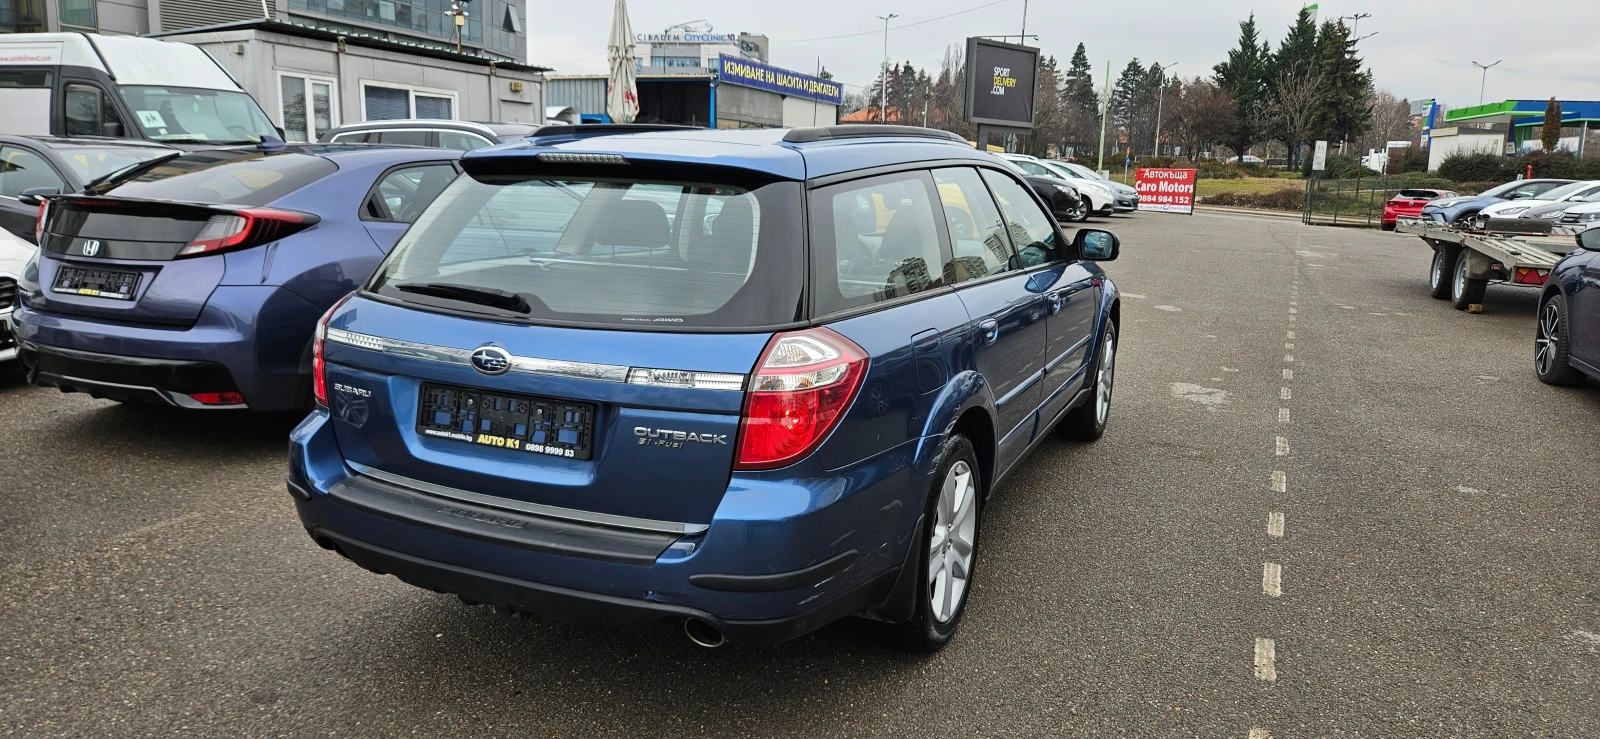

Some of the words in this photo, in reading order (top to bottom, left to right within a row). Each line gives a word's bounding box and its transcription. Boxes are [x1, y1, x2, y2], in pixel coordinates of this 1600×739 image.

[994, 66, 1010, 77] SPORT
[724, 60, 764, 82] ИЗМИВАНЕ
[765, 70, 775, 83] НА
[776, 73, 803, 90] ШАСИТА
[803, 80, 809, 91] И
[808, 81, 839, 98] ДВИГАТЕЛИ
[994, 76, 1016, 87] DELIVERY
[991, 85, 1005, 95] .COM
[1135, 180, 1157, 191] Caro
[1158, 180, 1194, 193] Motors
[1157, 195, 1173, 203] 984
[1174, 196, 1190, 204] 152
[334, 382, 372, 397] SUBARU
[633, 426, 728, 445] OUTBACK
[477, 434, 505, 446] AUTO
[506, 438, 520, 449] K1
[525, 443, 543, 453] 0898
[545, 446, 563, 456] 9999
[564, 449, 574, 458] 83
